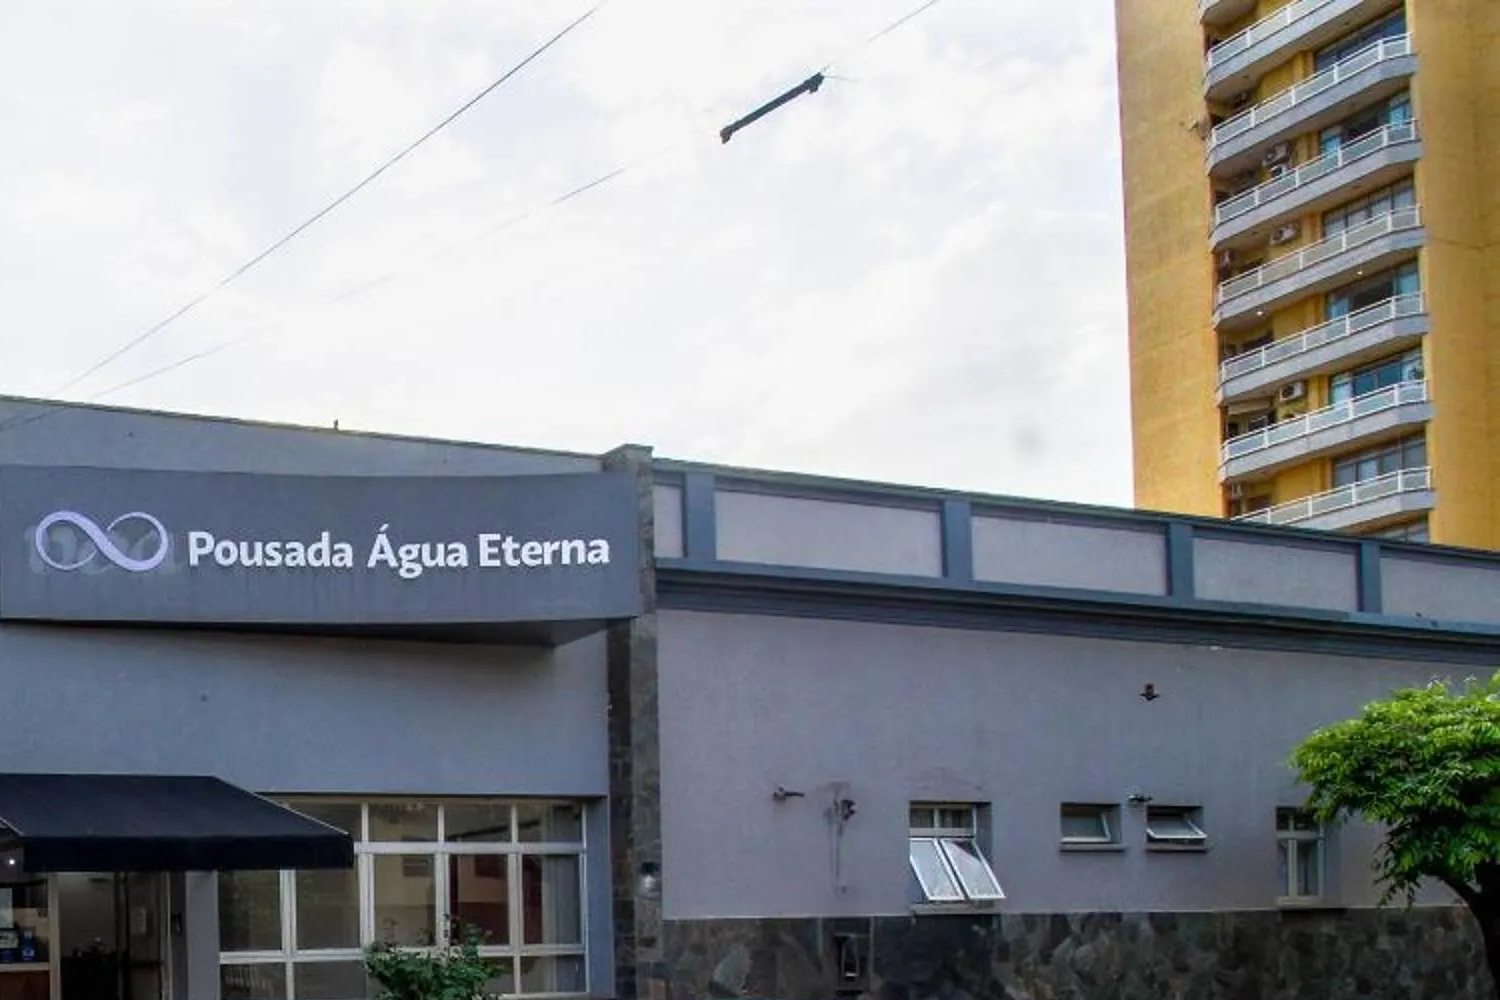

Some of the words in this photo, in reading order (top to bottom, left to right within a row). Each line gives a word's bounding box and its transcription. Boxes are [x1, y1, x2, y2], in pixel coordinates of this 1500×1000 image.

[188, 530, 353, 567] Pousada
[367, 523, 468, 578] Água
[478, 533, 610, 566] Eterna
